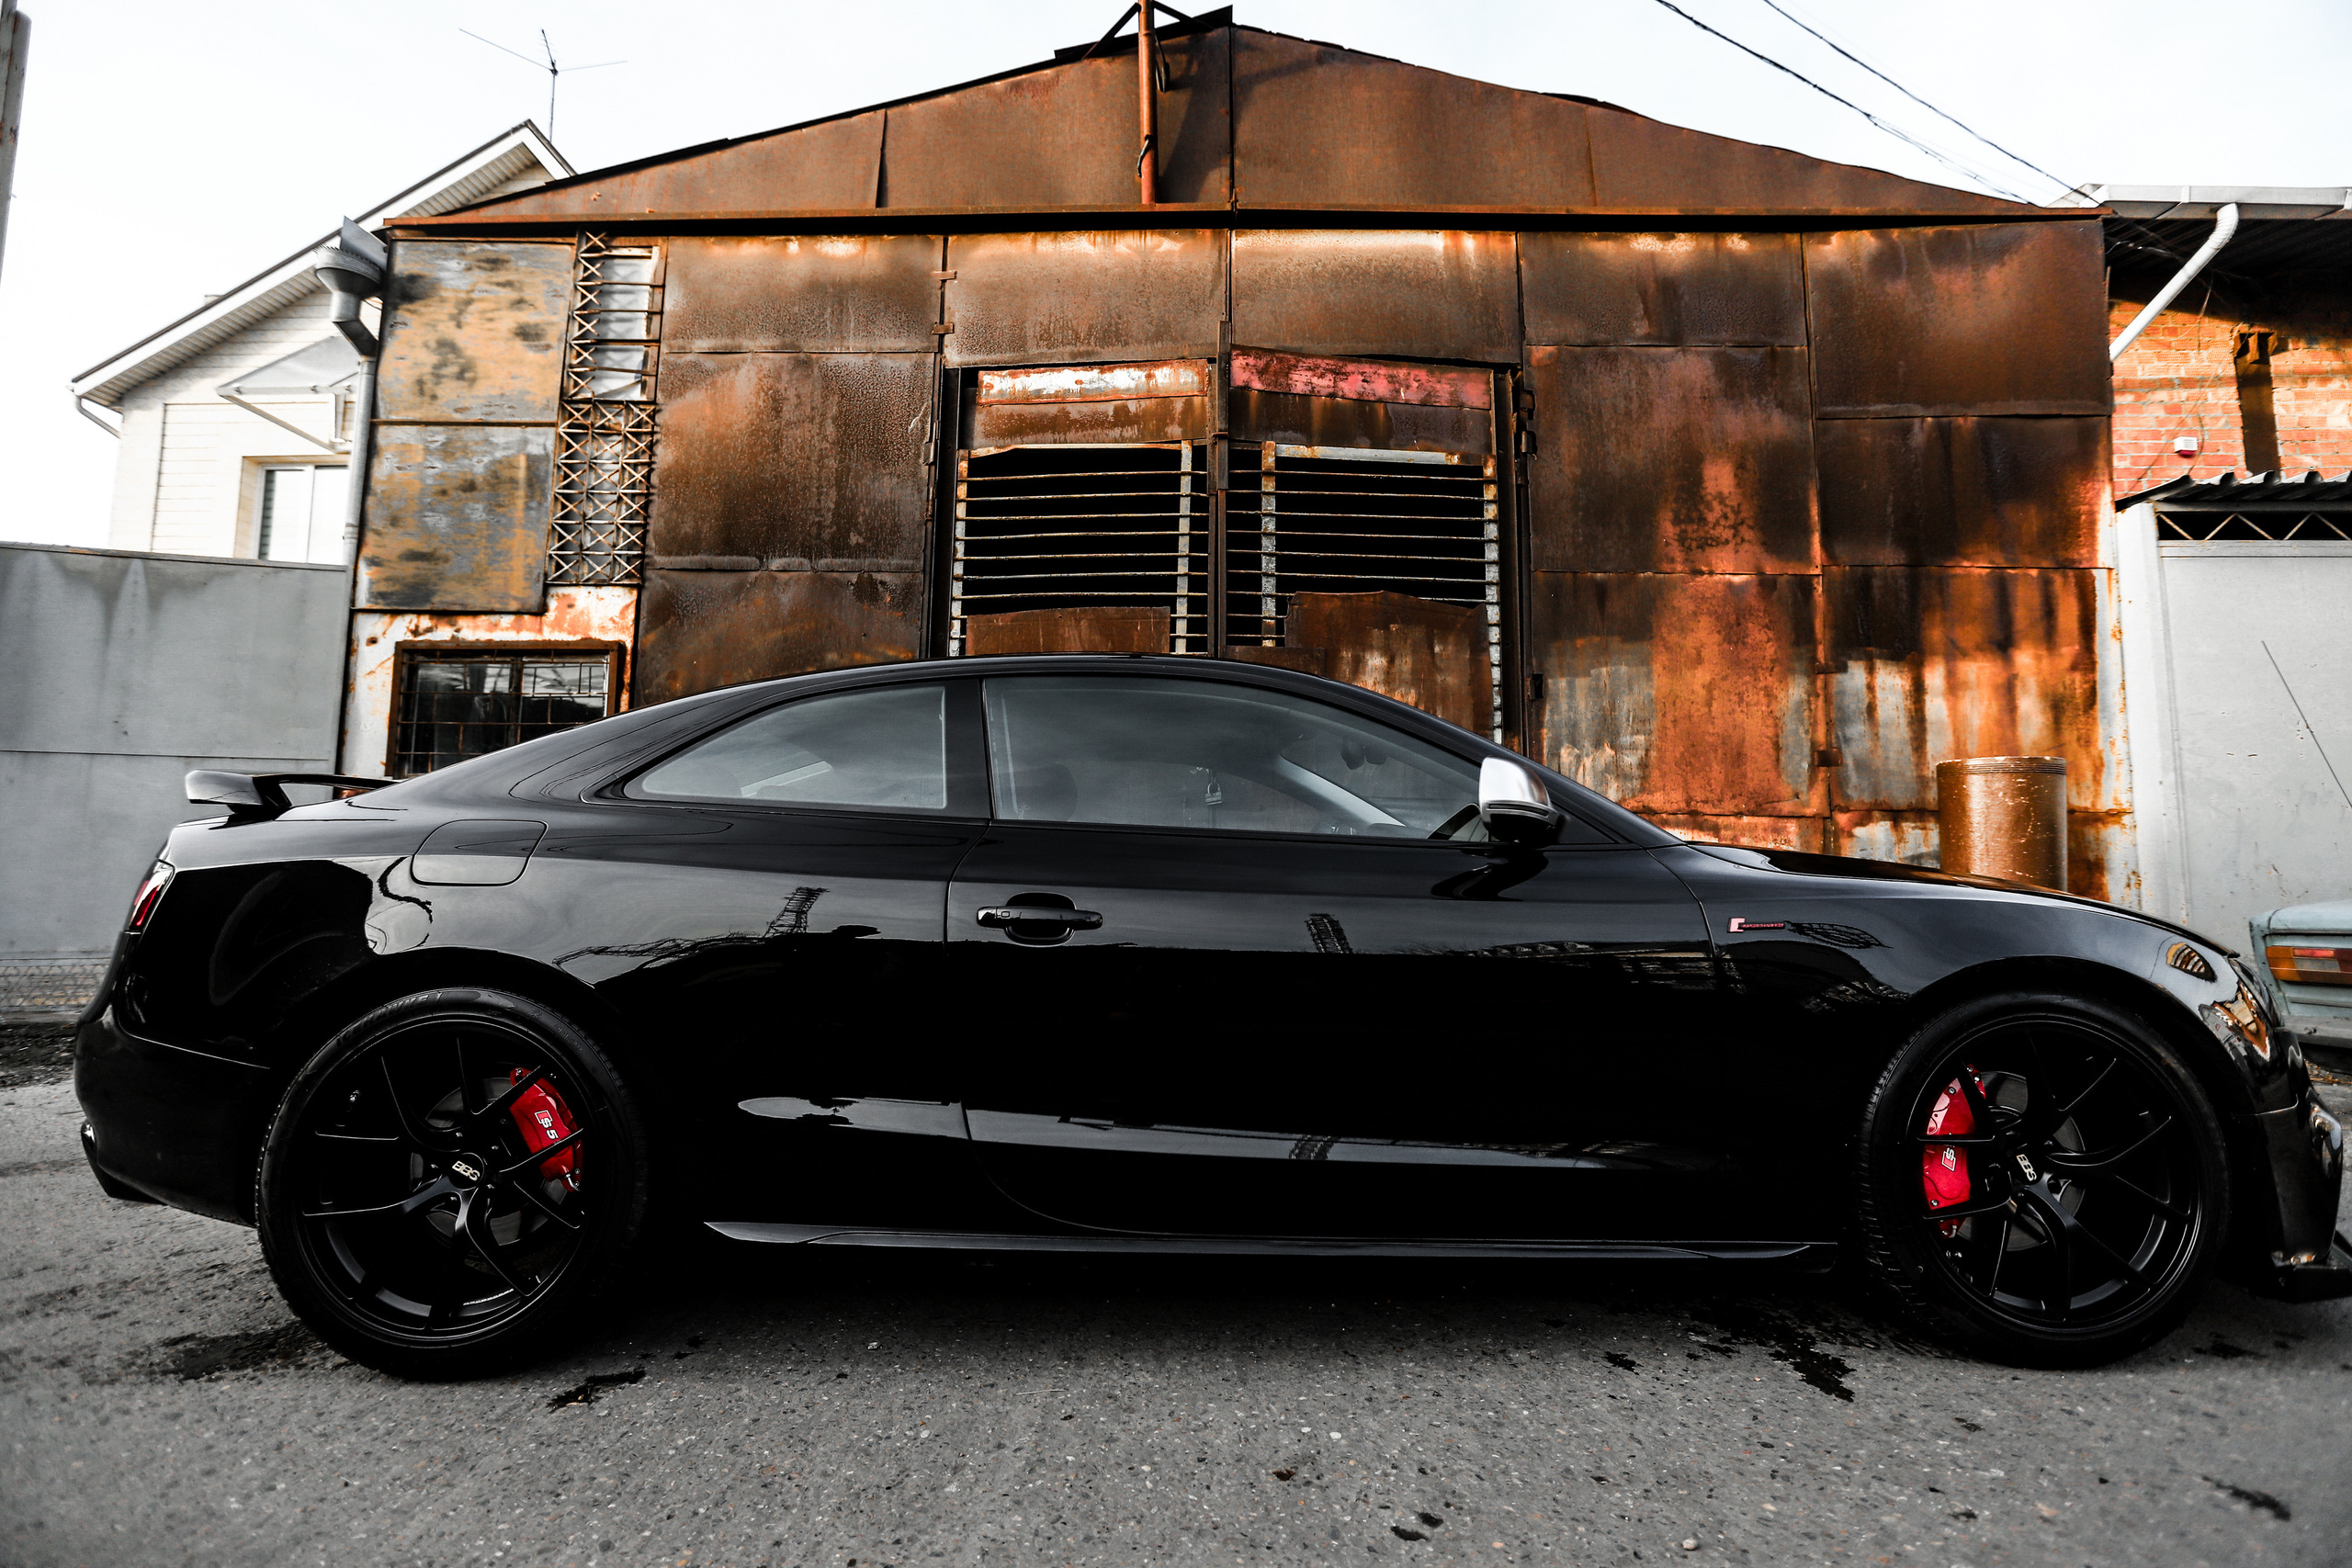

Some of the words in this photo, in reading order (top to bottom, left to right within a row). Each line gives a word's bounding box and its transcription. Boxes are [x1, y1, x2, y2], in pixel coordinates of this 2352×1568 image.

[540, 1117, 560, 1140] S5
[451, 1160, 481, 1181] BBS
[2016, 1154, 2038, 1182] BBS
